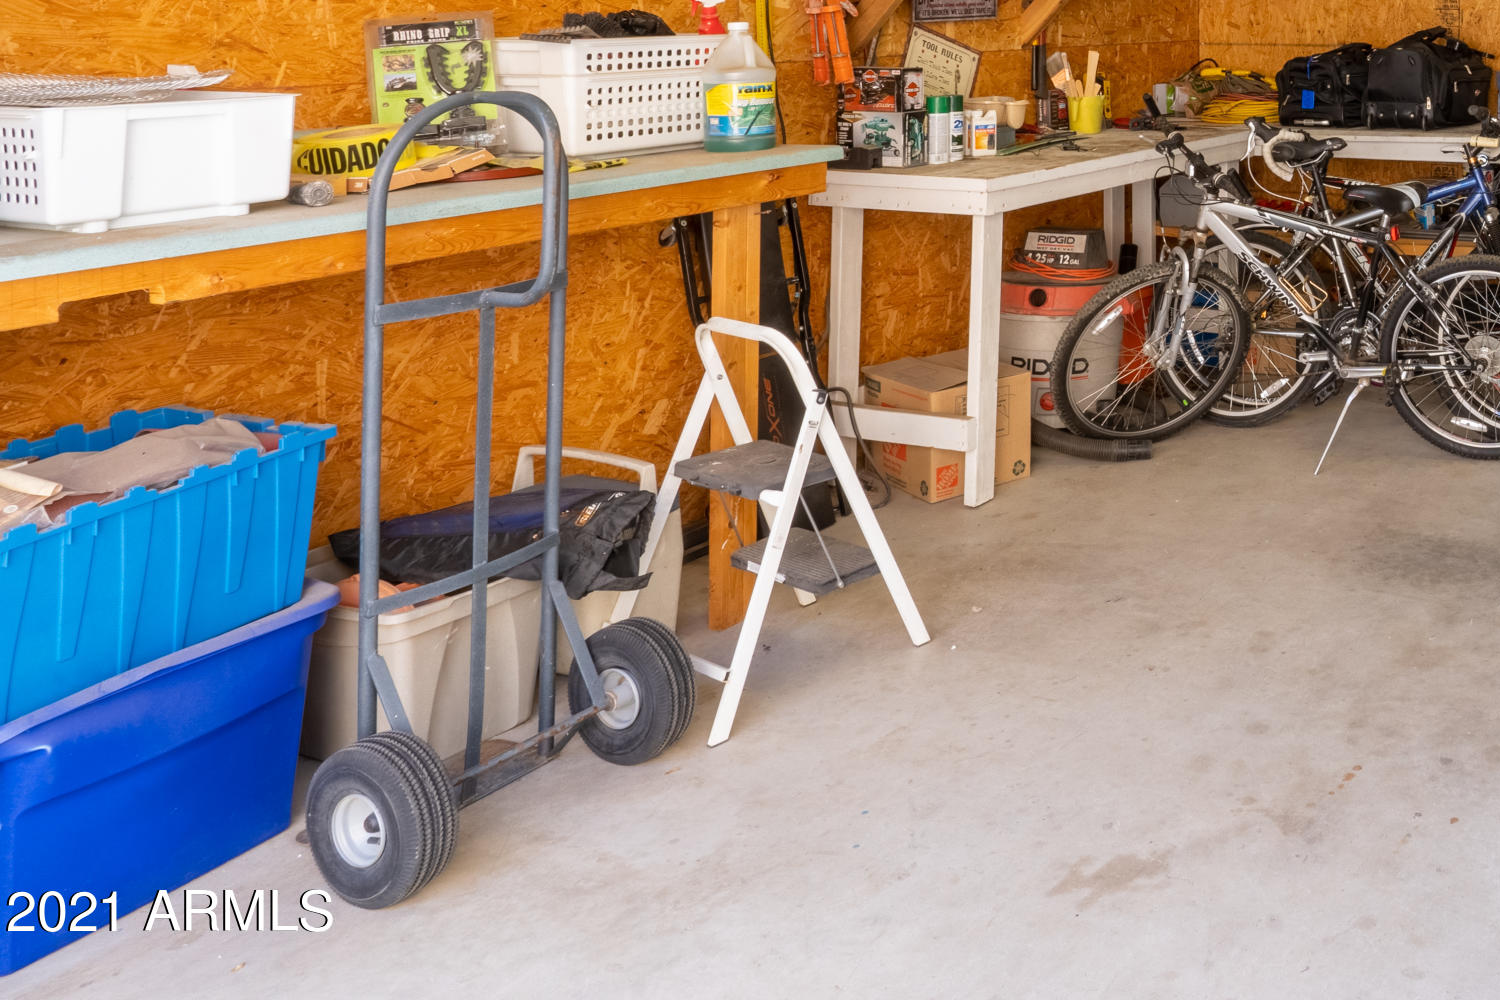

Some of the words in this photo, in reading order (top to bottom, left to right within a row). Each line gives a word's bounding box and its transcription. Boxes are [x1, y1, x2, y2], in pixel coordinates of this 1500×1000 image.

[392, 28, 423, 42] RHINO
[427, 27, 451, 39] GRIP
[456, 25, 469, 37] XL
[921, 39, 939, 54] TOOL
[941, 47, 963, 64] RULES
[1037, 234, 1075, 245] RIDGID
[1059, 254, 1070, 264] 12
[1236, 250, 1304, 318] SCHWINN
[1011, 356, 1089, 376] RIDD
